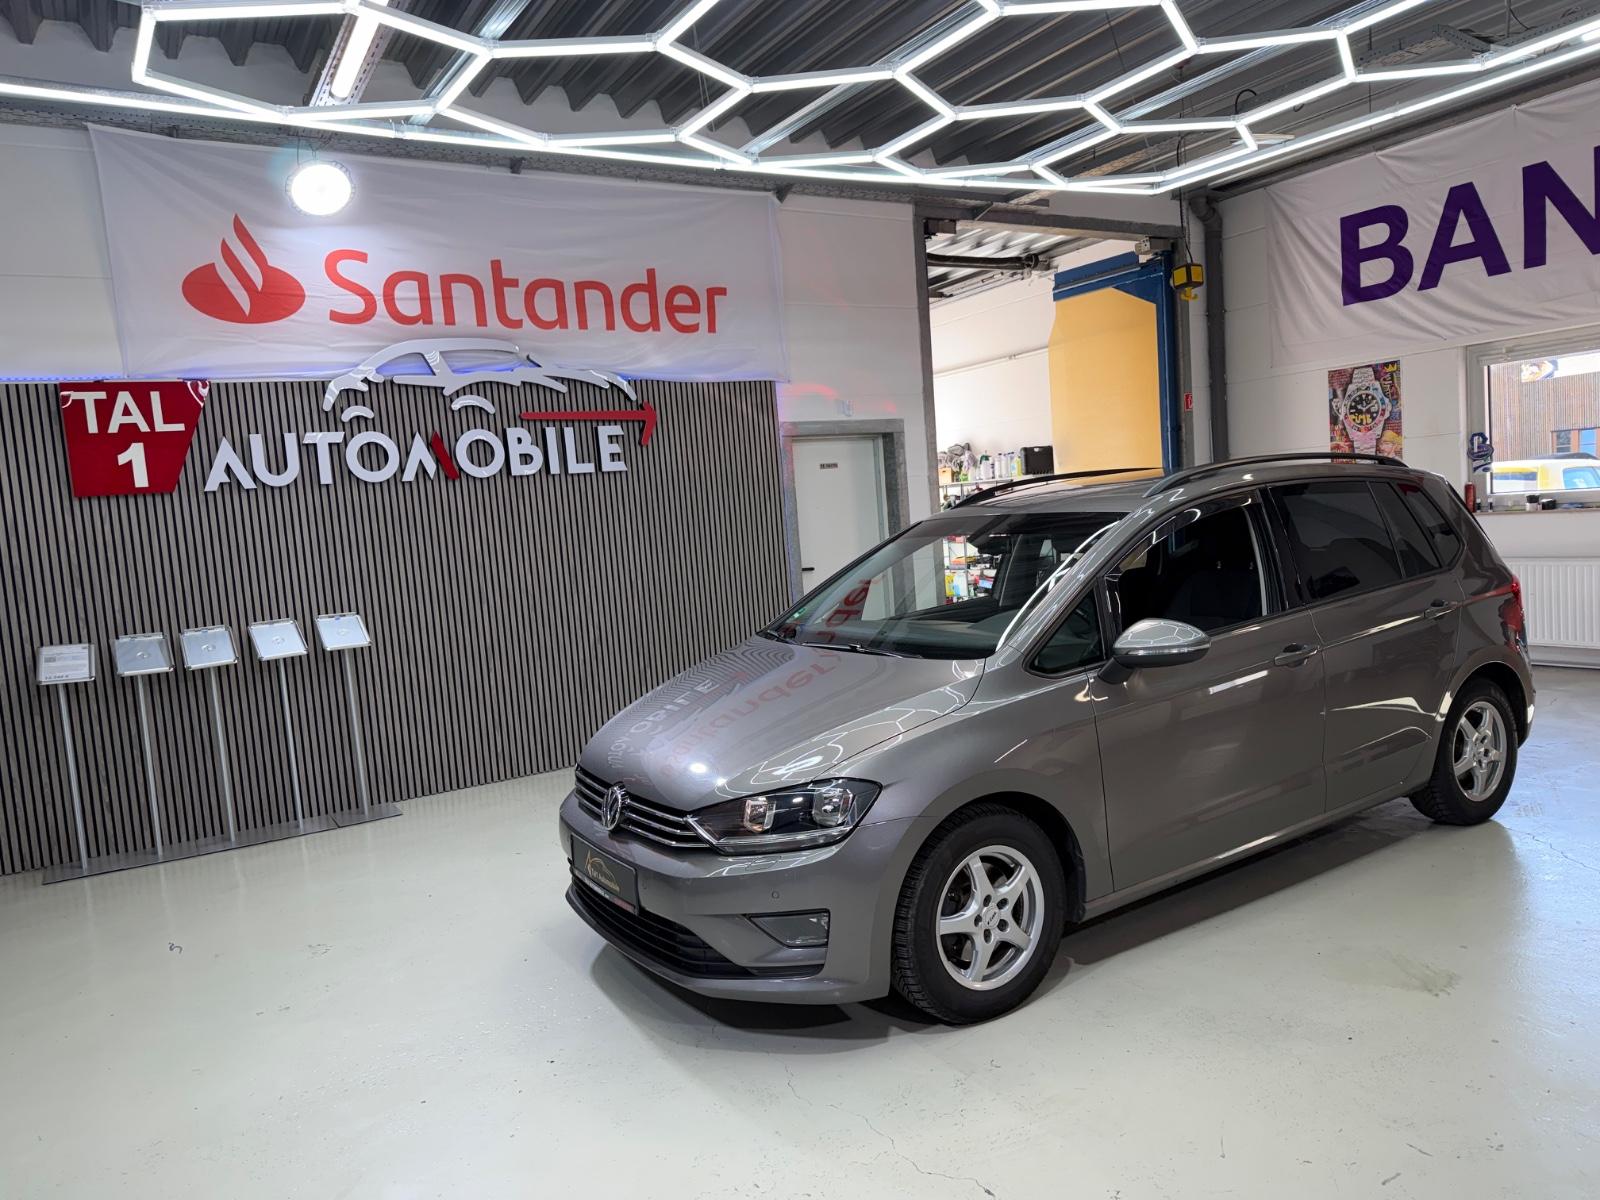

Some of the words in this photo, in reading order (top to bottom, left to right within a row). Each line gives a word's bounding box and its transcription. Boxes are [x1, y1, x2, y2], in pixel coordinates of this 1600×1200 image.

[1340, 145, 1600, 306] BAN
[324, 249, 727, 334] Santander
[69, 390, 186, 434] TAL
[117, 442, 149, 488] 1
[204, 425, 628, 492] AUTOMOBILE
